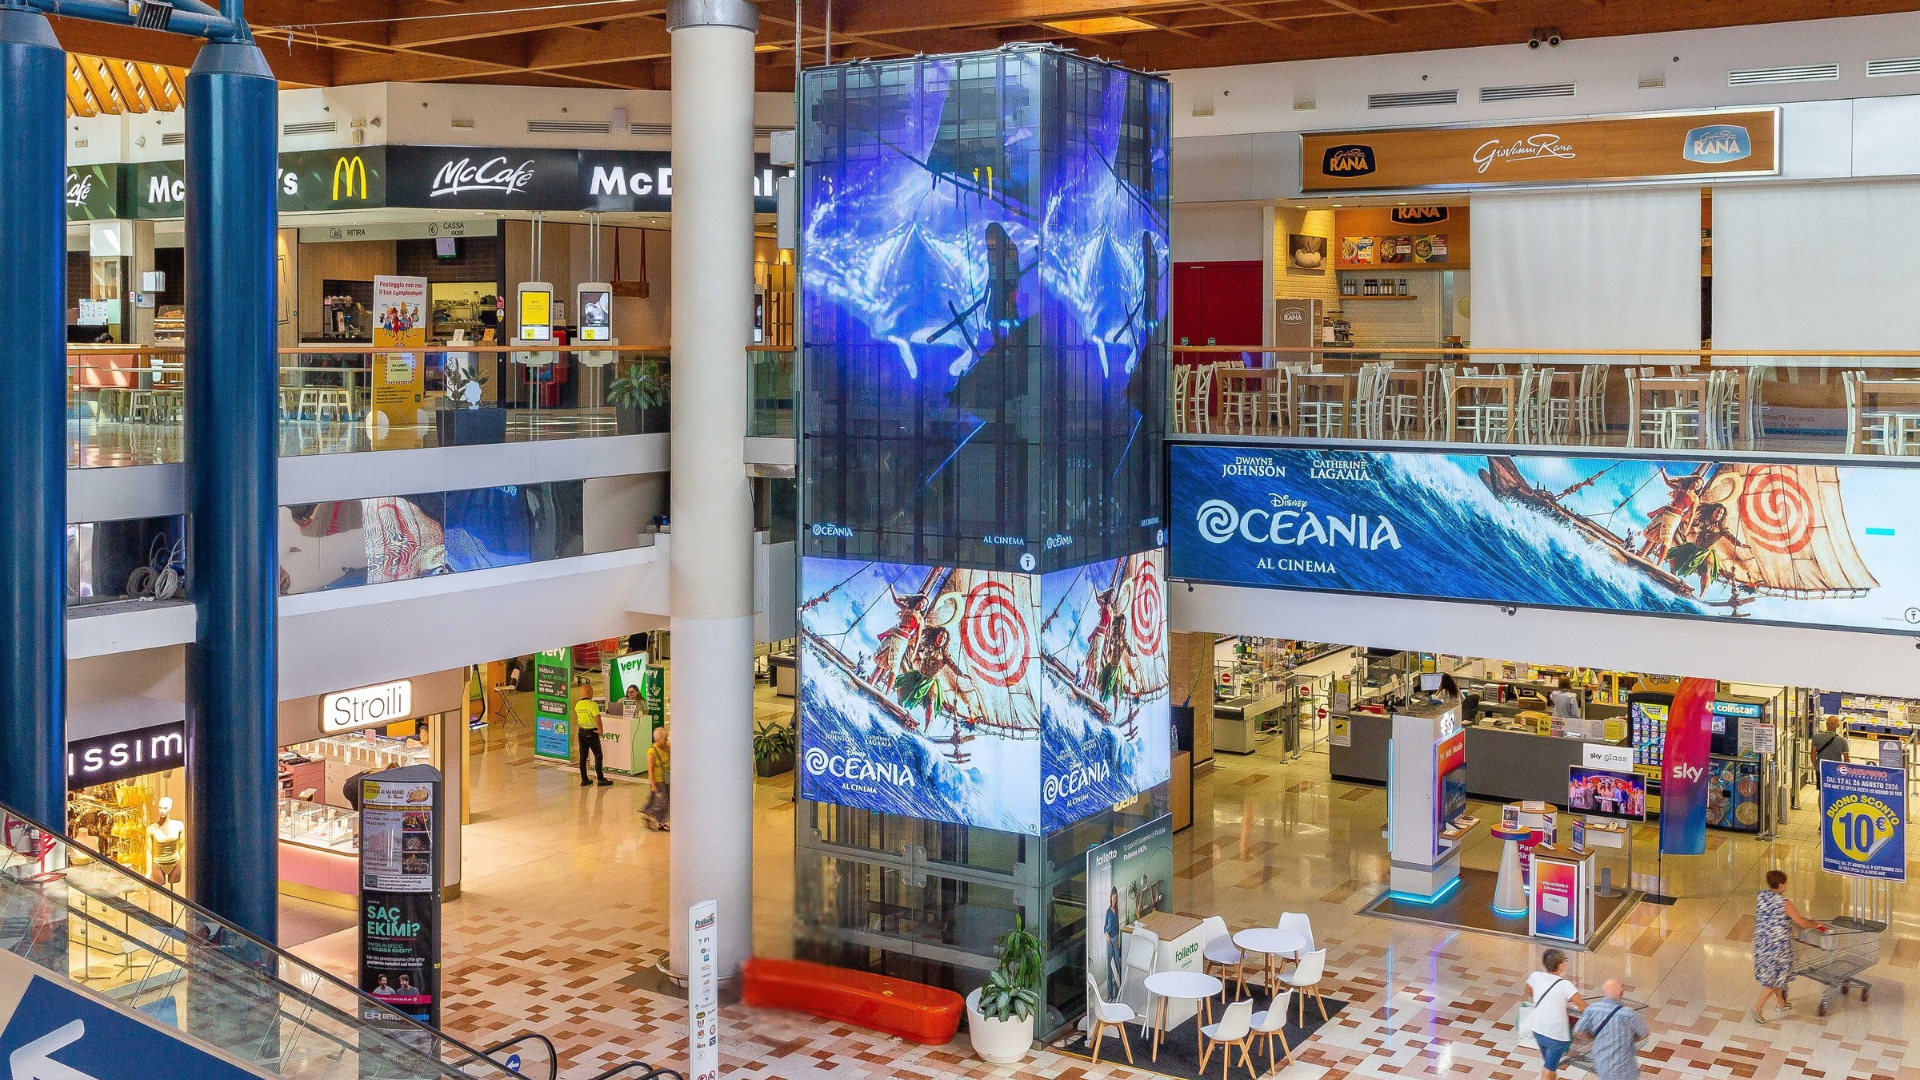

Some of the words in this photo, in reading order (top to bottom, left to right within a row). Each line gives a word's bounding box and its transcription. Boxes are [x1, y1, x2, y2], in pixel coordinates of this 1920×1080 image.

[1526, 133, 1576, 159] Rana
[1694, 139, 1741, 155] RANA
[1330, 157, 1368, 172] RANA
[430, 157, 535, 197] McCafé
[1399, 206, 1440, 219] RANA
[443, 222, 465, 230] CASSA
[1235, 456, 1273, 466] DWAYNE
[1313, 460, 1366, 470] CATHERINE
[1222, 464, 1286, 478] JOHNSON
[812, 524, 854, 537] OCEANIA
[1197, 499, 1402, 551] OCEANIA
[983, 536, 993, 544] AL
[994, 536, 1025, 546] CINEMA
[1256, 558, 1275, 569] AL
[1278, 559, 1337, 574] CINEMA
[621, 659, 643, 672] very
[335, 686, 402, 726] Stroili
[1717, 705, 1755, 715] coinstar
[1590, 752, 1602, 760] sky
[1604, 751, 1627, 762] glass
[805, 747, 916, 787] OCEANIA
[1673, 762, 1704, 783] sky
[851, 784, 878, 794] CINEMA
[1043, 759, 1111, 805] OCEANIA
[1861, 781, 1884, 789] AGOSTO
[1885, 783, 1899, 791] 2026
[1826, 794, 1858, 818] BUONO
[1861, 795, 1900, 826] SCONTO
[1096, 849, 1118, 867] folletto
[367, 906, 400, 924] SAÇ
[1175, 942, 1199, 963] folletto
